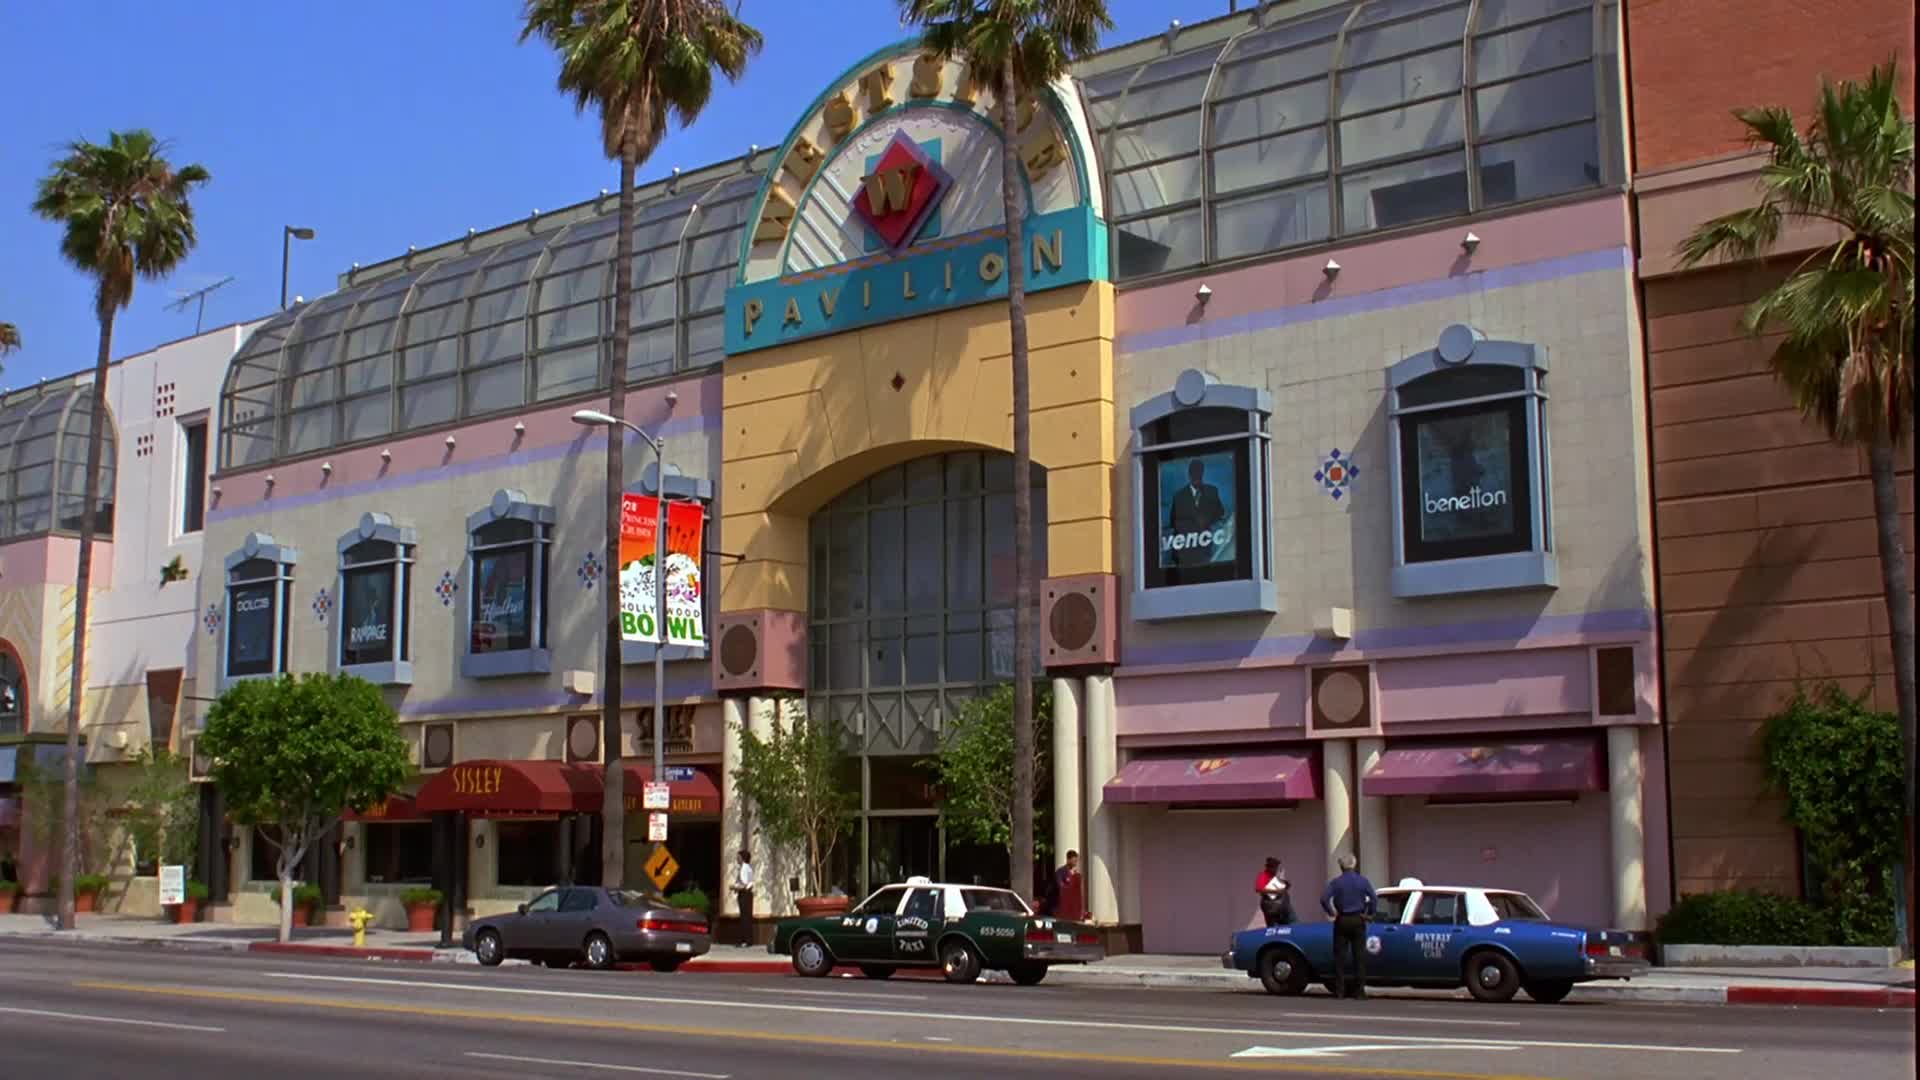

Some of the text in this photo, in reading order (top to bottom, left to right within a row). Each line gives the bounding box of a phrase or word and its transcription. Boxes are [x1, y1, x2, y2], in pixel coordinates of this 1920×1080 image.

[743, 228, 1063, 336] PAVILION
[1424, 485, 1507, 514] benetton
[453, 767, 502, 793] SISLEY
[896, 916, 929, 931] UNITED
[899, 938, 926, 953] TAXI
